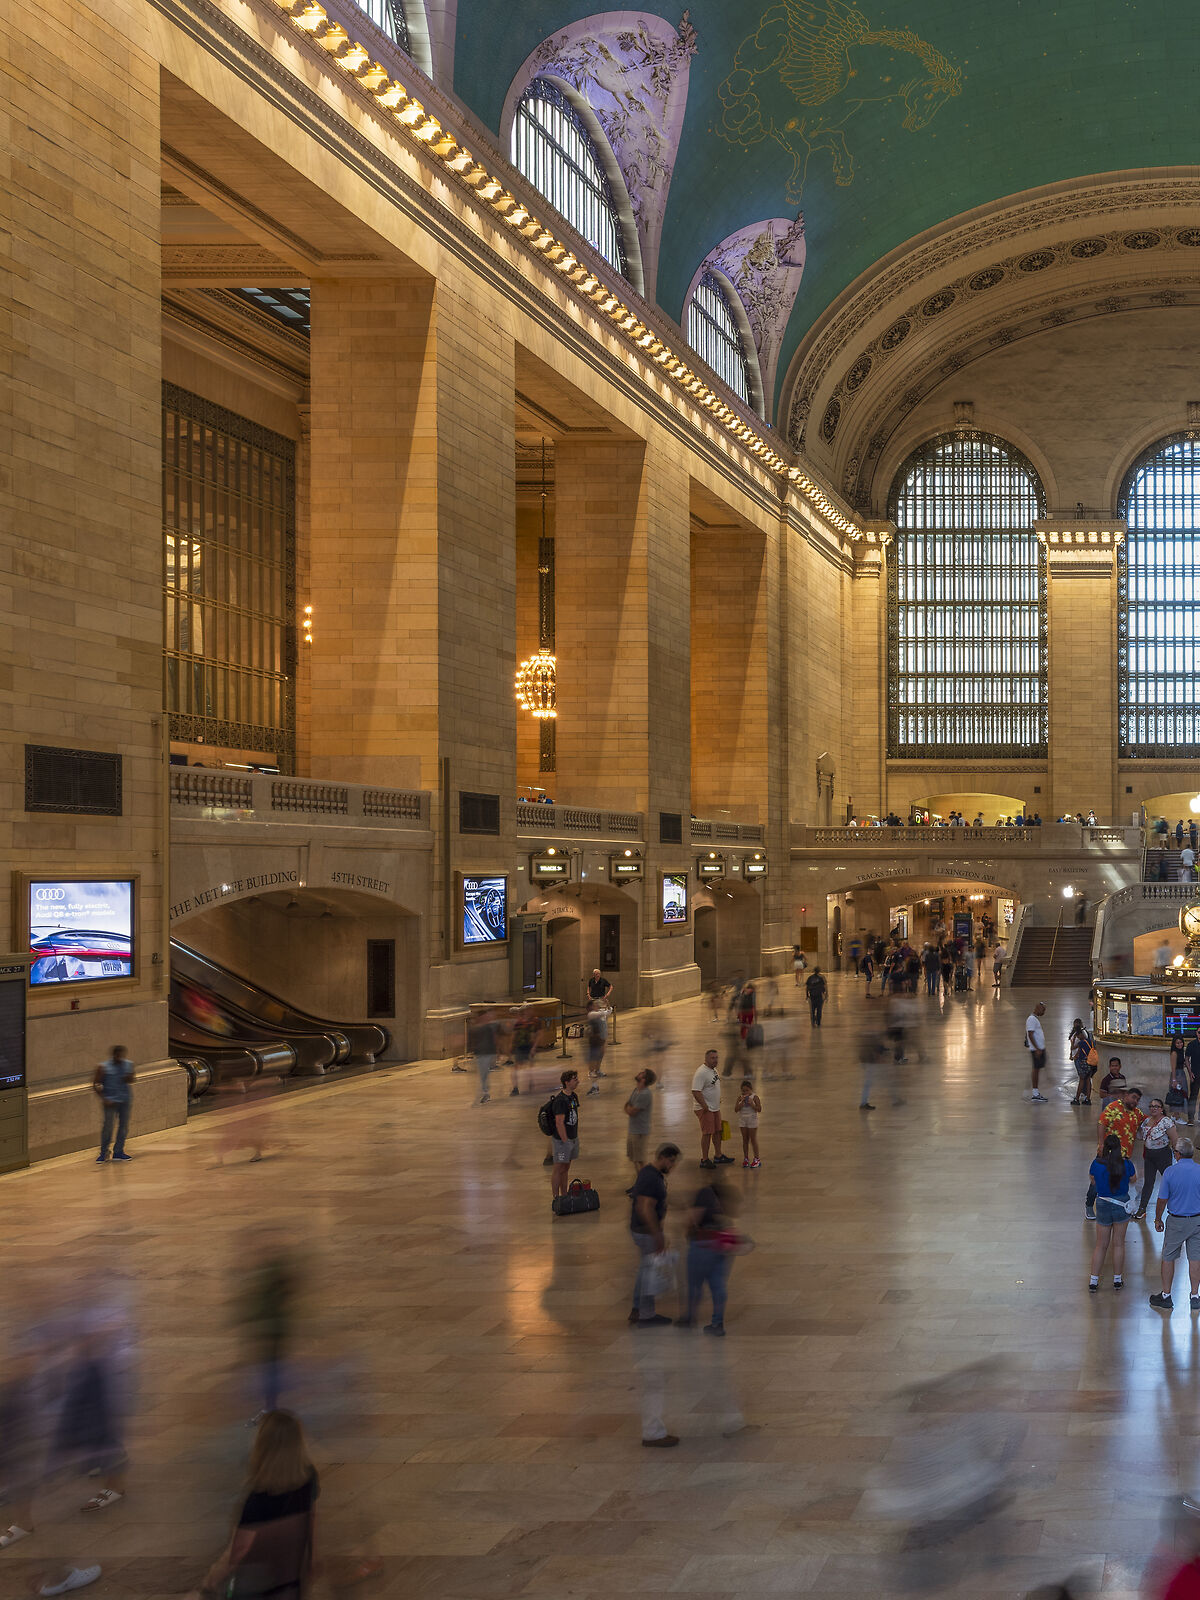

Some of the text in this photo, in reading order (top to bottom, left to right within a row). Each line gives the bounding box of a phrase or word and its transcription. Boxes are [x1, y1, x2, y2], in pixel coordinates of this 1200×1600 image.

[856, 872, 884, 881] TRACKS
[936, 867, 981, 879] LEXINGTON
[331, 872, 390, 892] 45TH STREET
[169, 900, 192, 920] THE
[246, 870, 297, 890] BUILDING
